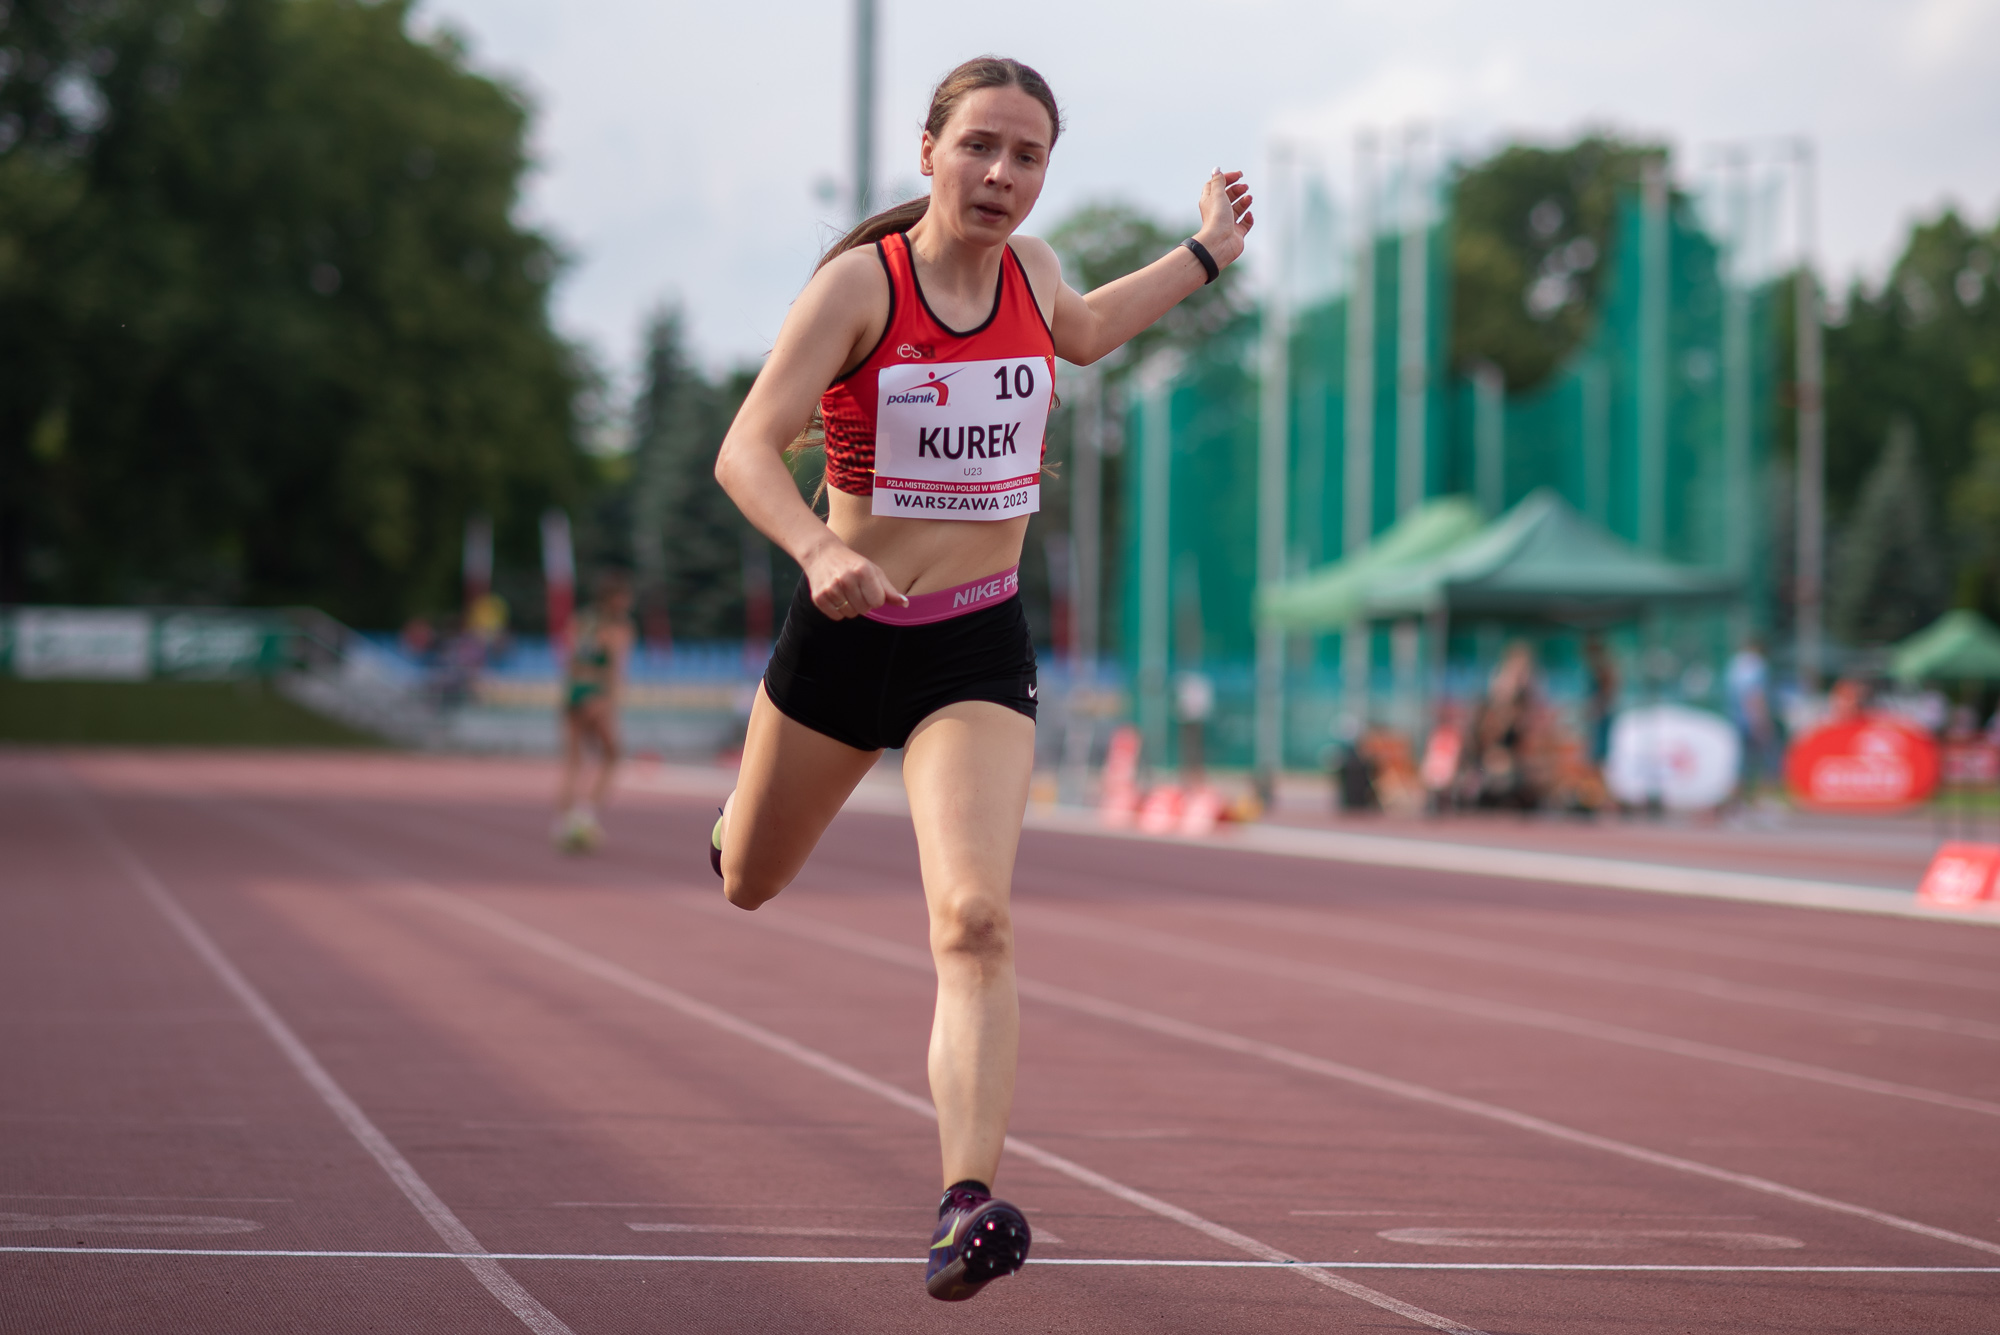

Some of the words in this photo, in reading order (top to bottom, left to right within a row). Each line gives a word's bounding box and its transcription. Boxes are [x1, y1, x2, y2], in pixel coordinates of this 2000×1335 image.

[993, 364, 1034, 400] 10
[886, 392, 936, 406] polanik
[918, 421, 1021, 460] KUREK
[963, 467, 982, 477] U23
[886, 479, 904, 488] PZLA
[904, 481, 956, 492] MISTRZOSTWA
[956, 484, 980, 492] POLSKI
[981, 484, 989, 492] W
[1022, 476, 1033, 485] 2023
[894, 493, 999, 511] WARSZAWA
[1003, 490, 1028, 509] 2023
[953, 579, 1001, 608] NIKE
